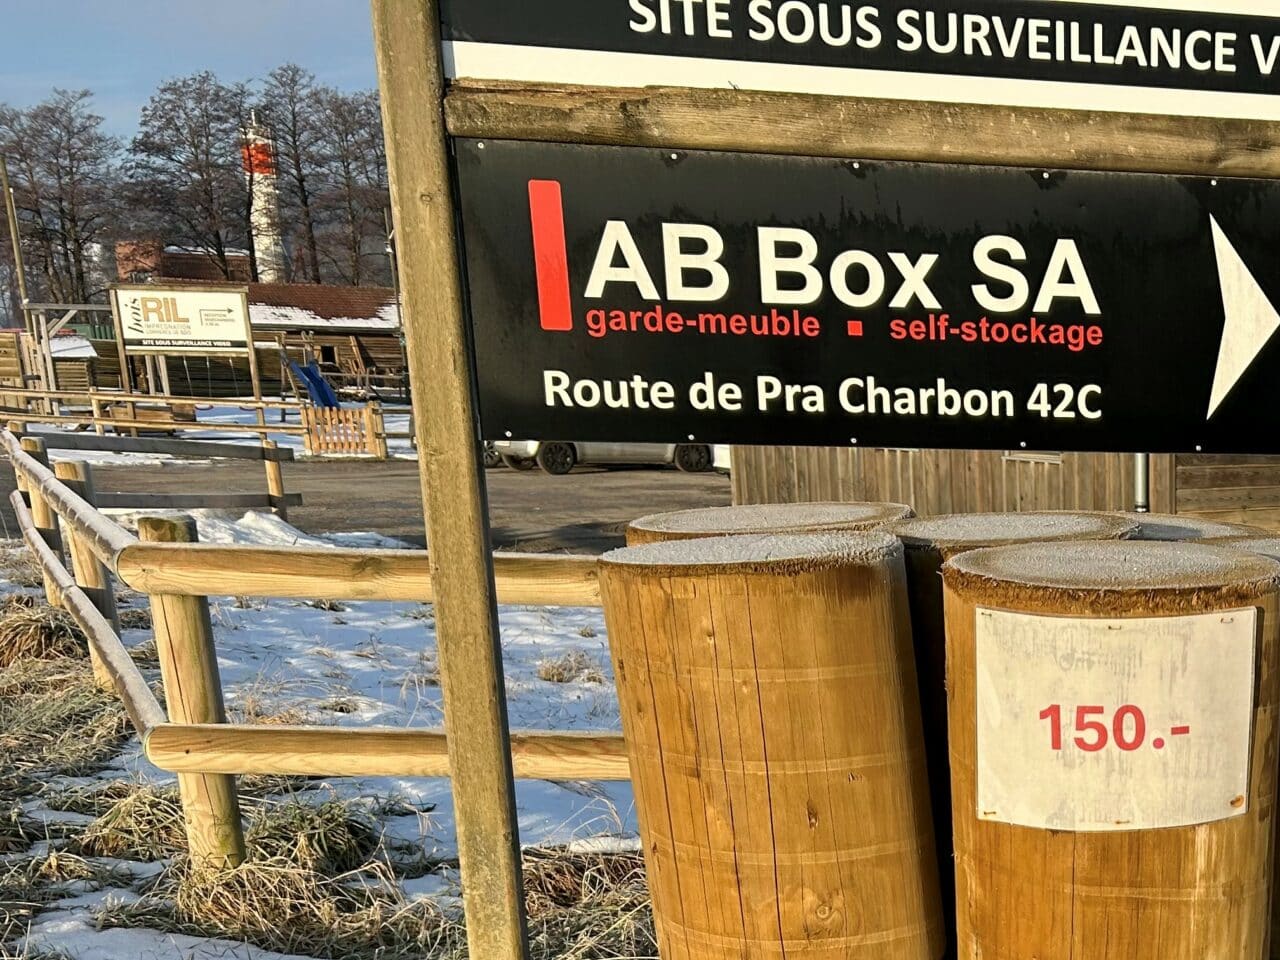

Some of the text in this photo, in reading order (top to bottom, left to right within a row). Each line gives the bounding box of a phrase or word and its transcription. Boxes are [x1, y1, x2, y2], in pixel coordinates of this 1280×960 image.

[628, 0, 733, 39] SITE
[748, 0, 883, 49] SOUS
[896, 8, 1237, 74] SURVEILLANCE
[583, 220, 1102, 315] AB Box SA
[140, 297, 189, 323] RIL
[585, 305, 1103, 352] garde-meuble self-stockage
[543, 371, 1102, 419] Route de Pra Charbon 42C
[1039, 704, 1190, 752] 150.-
